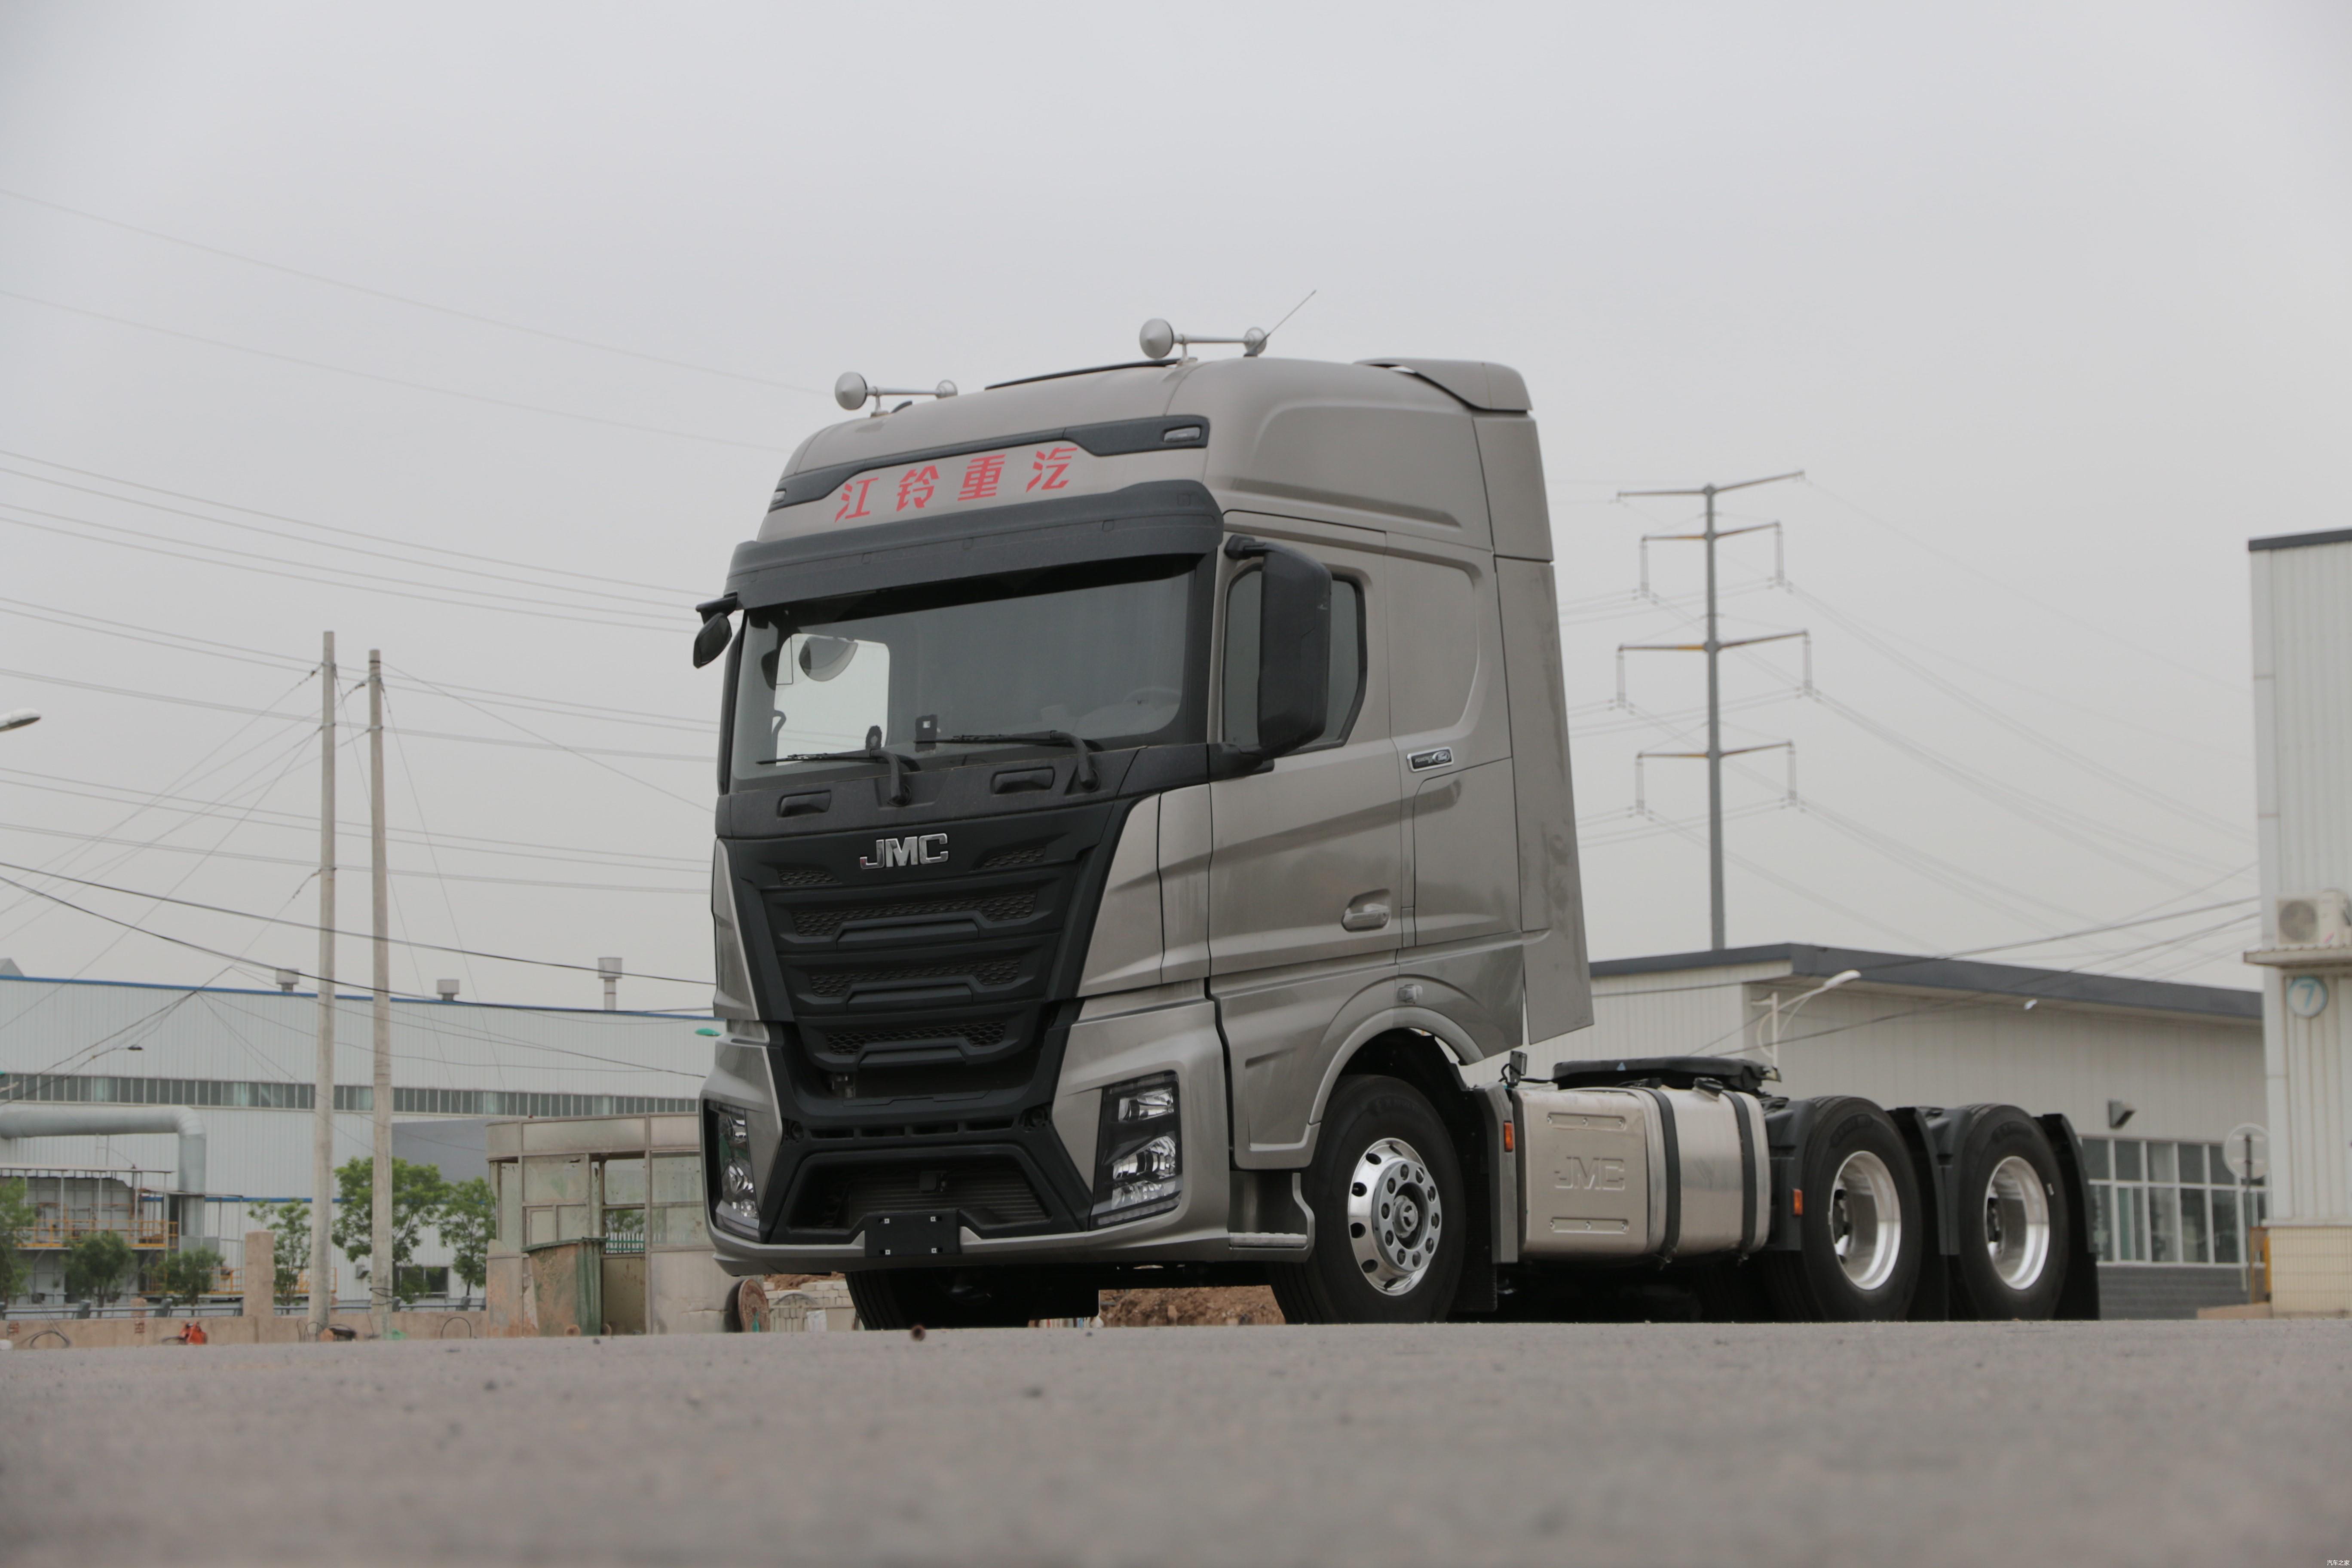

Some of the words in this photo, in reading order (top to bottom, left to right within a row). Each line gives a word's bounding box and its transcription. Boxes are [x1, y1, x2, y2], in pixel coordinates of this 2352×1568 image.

[836, 447, 1078, 521] 江铃重汽
[860, 833, 948, 870] JMC
[2300, 984, 2315, 1008] 7
[1554, 1157, 1625, 1190] JMC
